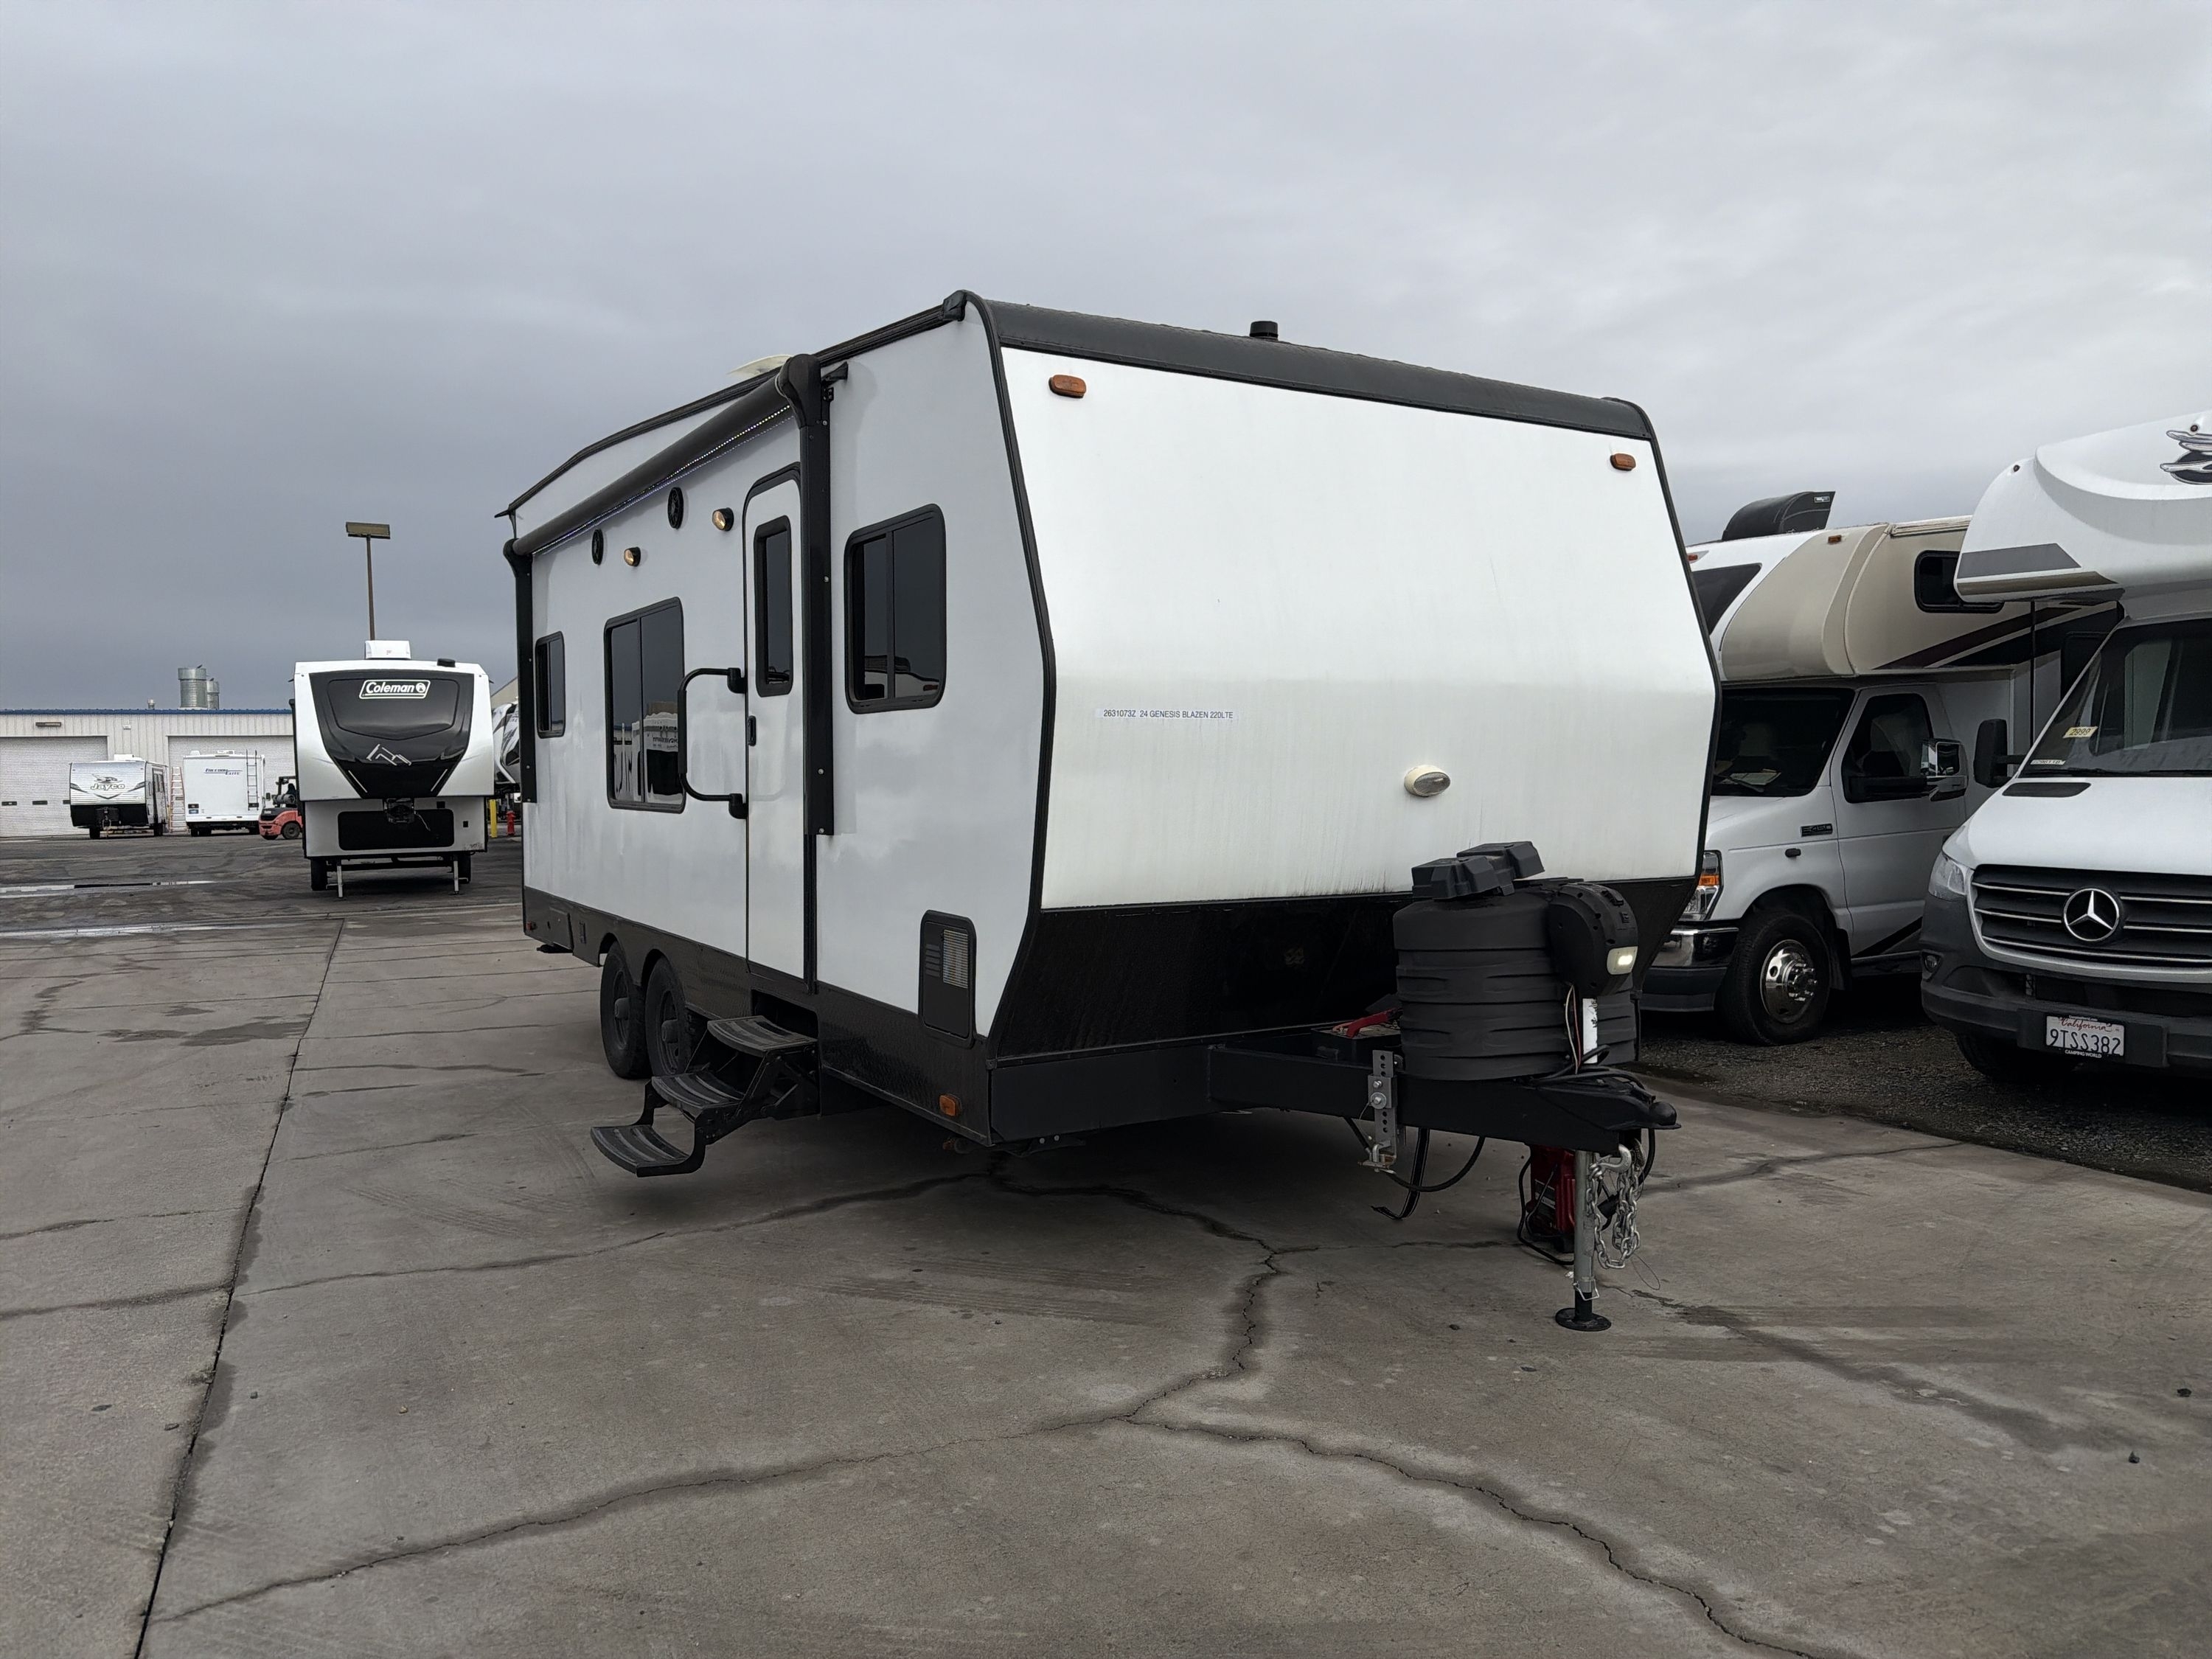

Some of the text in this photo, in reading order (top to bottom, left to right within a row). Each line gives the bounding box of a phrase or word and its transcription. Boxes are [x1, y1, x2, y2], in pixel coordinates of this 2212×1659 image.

[366, 681, 415, 694] Coleman
[1103, 709, 1136, 717] 2631073Z
[1150, 710, 1180, 718] GENESIS
[1182, 711, 1208, 719] BLAZEN
[90, 783, 125, 791] Jayco
[2059, 1018, 2107, 1031] California
[2050, 1029, 2121, 1054] 9TSS382
